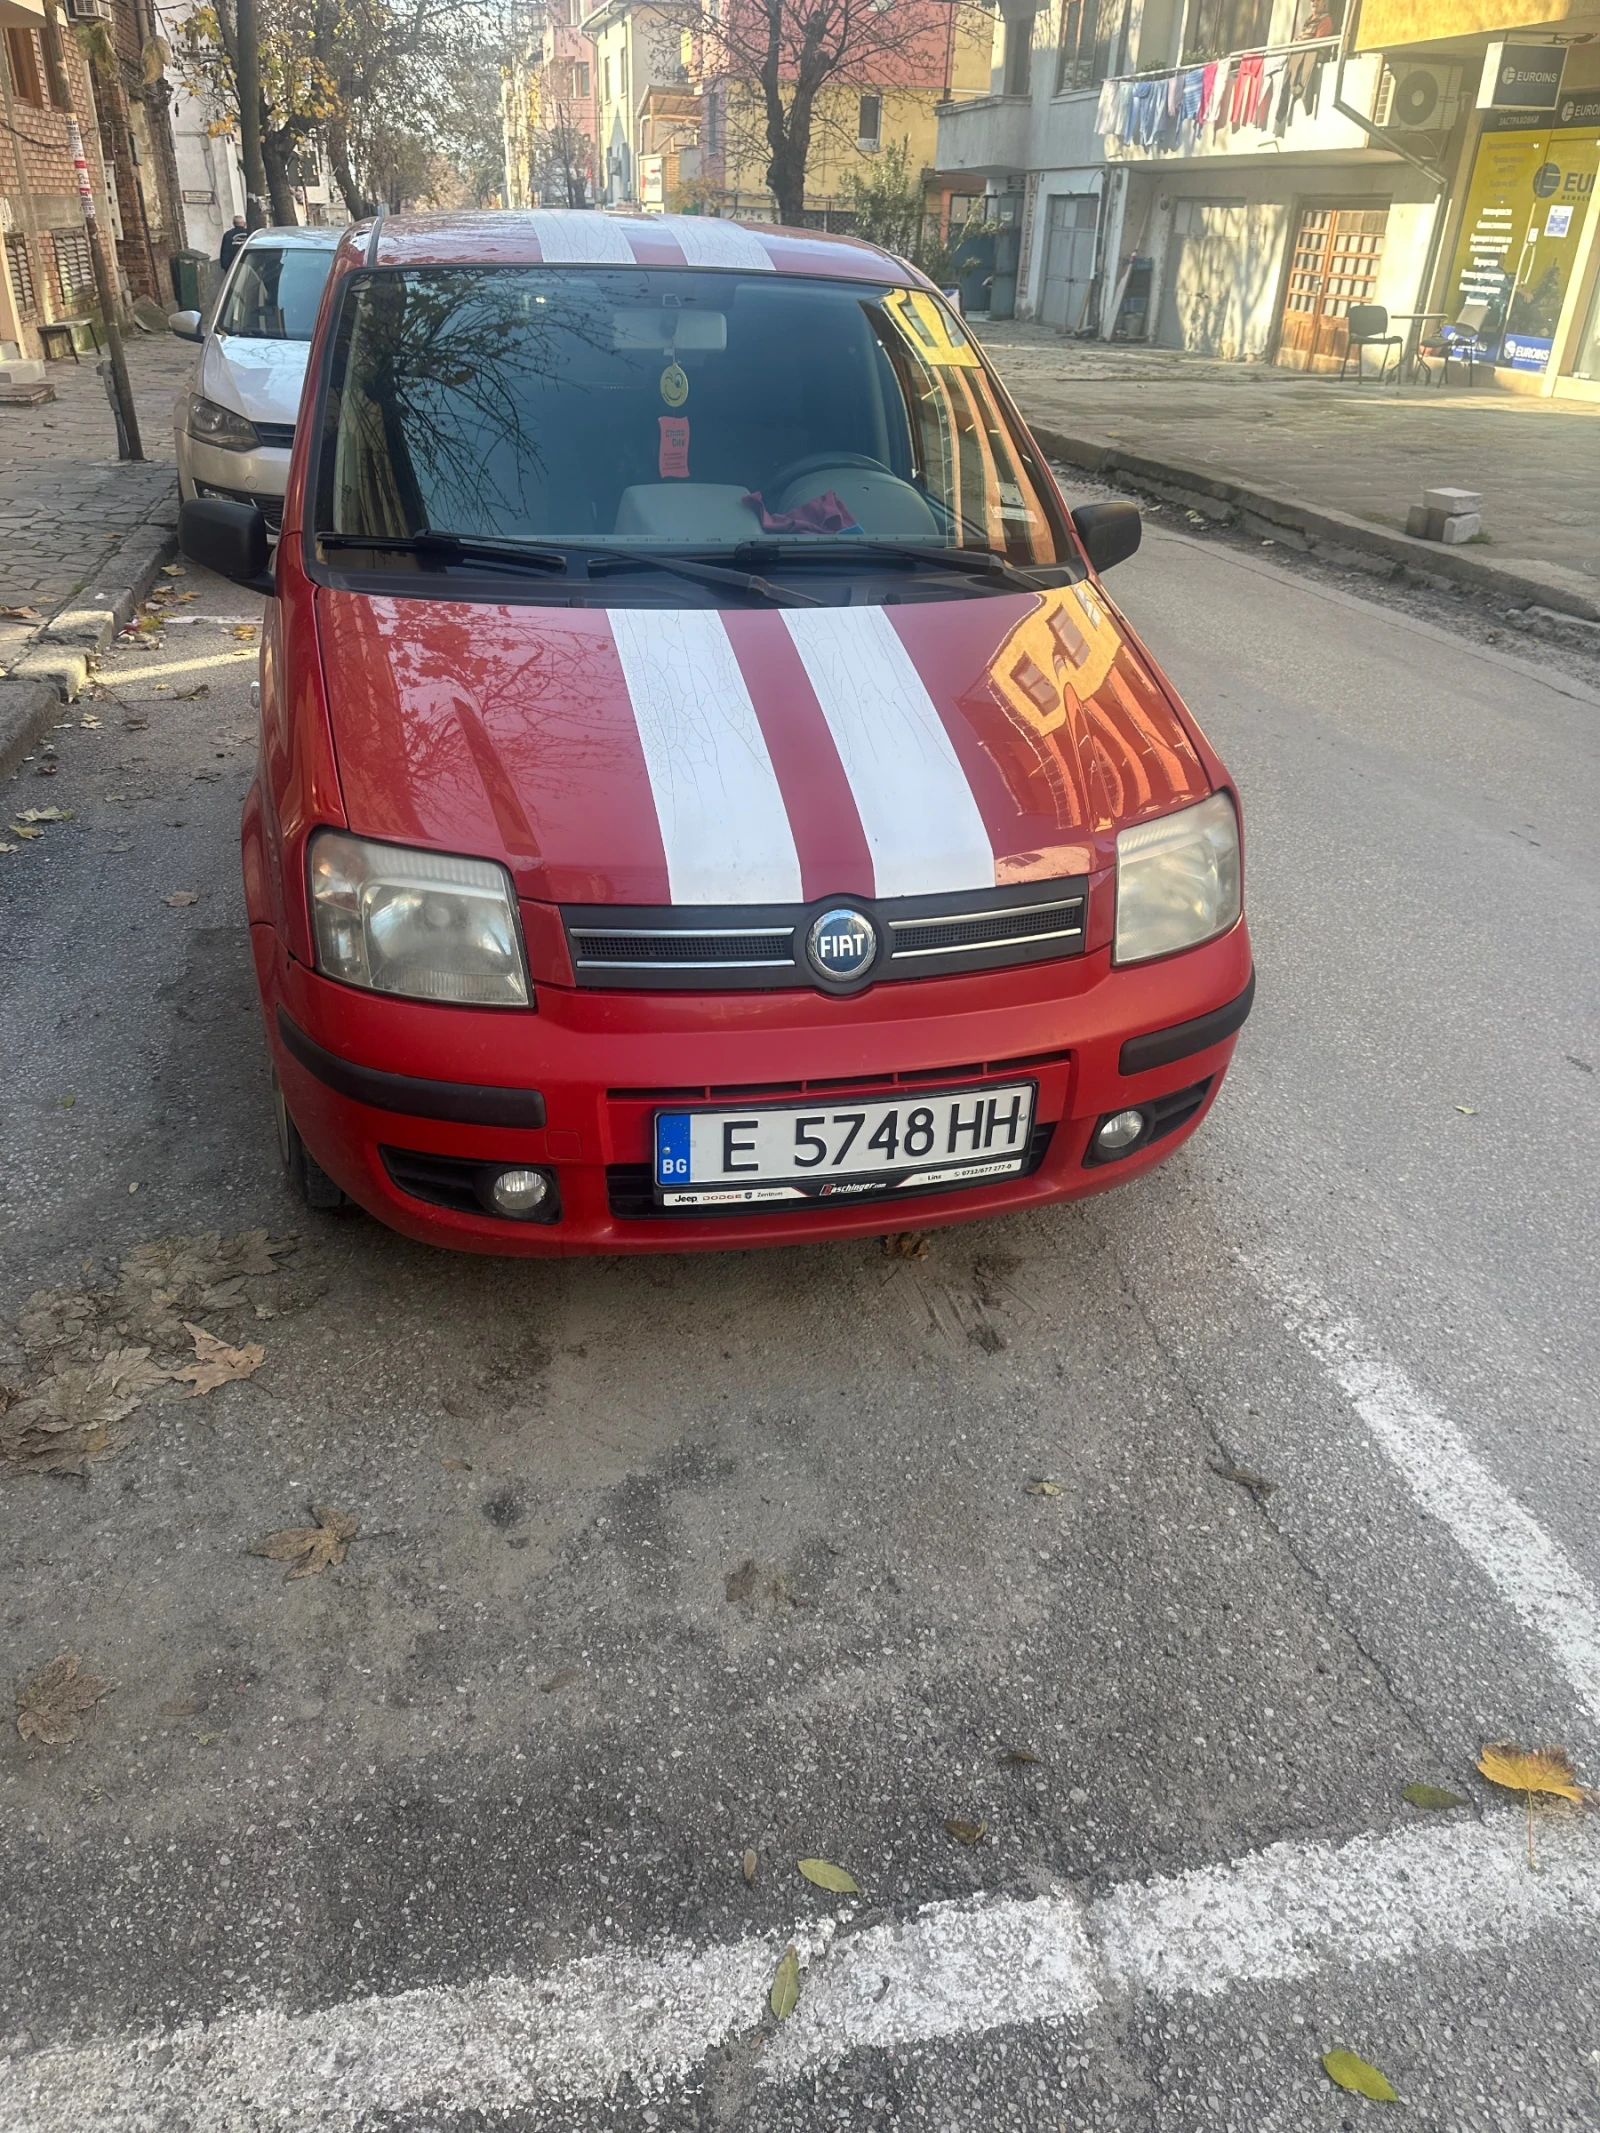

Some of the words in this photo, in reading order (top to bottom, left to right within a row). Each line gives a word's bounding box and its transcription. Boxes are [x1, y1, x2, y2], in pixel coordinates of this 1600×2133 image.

[1516, 71, 1558, 83] EUROINS
[1515, 346, 1550, 361] EUROINS
[820, 933, 865, 958] FIAT
[723, 1120, 759, 1173] E
[793, 1107, 935, 1168] 5748
[947, 1095, 1022, 1153] HH
[662, 1158, 687, 1174] BG
[674, 1194, 698, 1203] Jeep
[702, 1193, 742, 1201] DODGE
